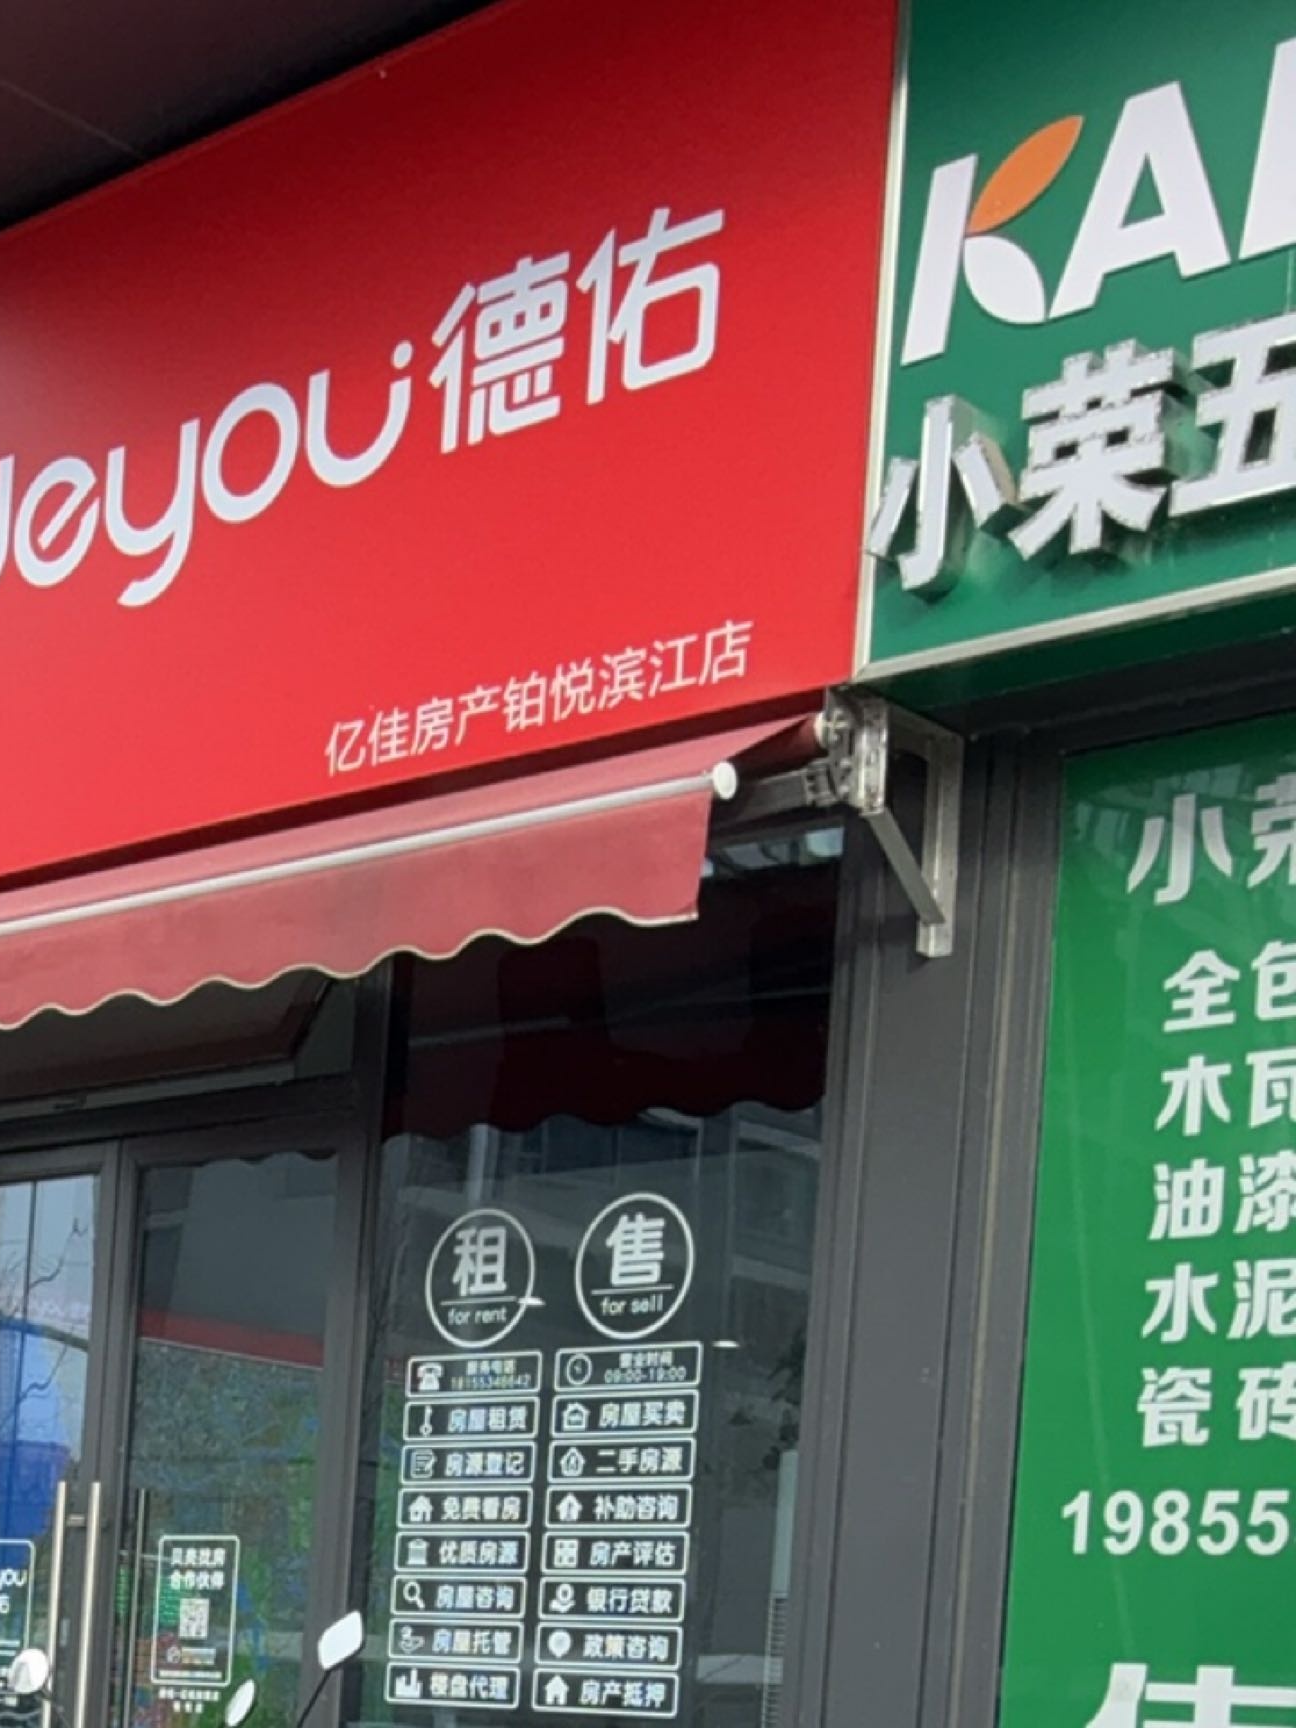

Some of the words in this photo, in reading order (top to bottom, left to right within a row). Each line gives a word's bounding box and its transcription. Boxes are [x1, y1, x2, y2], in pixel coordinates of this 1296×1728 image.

[429, 207, 724, 455] 德佑
[324, 618, 753, 777] 亿佳房产铂悦滨江店
[452, 1226, 507, 1296] 租
[605, 1211, 665, 1287] 售
[448, 1308, 471, 1325] for
[474, 1306, 507, 1324] rent
[603, 1298, 626, 1316] for
[630, 1294, 664, 1314] sell
[1141, 1258, 1296, 1343] 水泥
[1136, 1361, 1296, 1448] 瓷砖
[596, 1446, 684, 1475] 二手房源
[438, 1540, 519, 1566] 优质房源
[589, 1540, 676, 1568] 房产评估
[586, 1585, 673, 1614] 银行贷款
